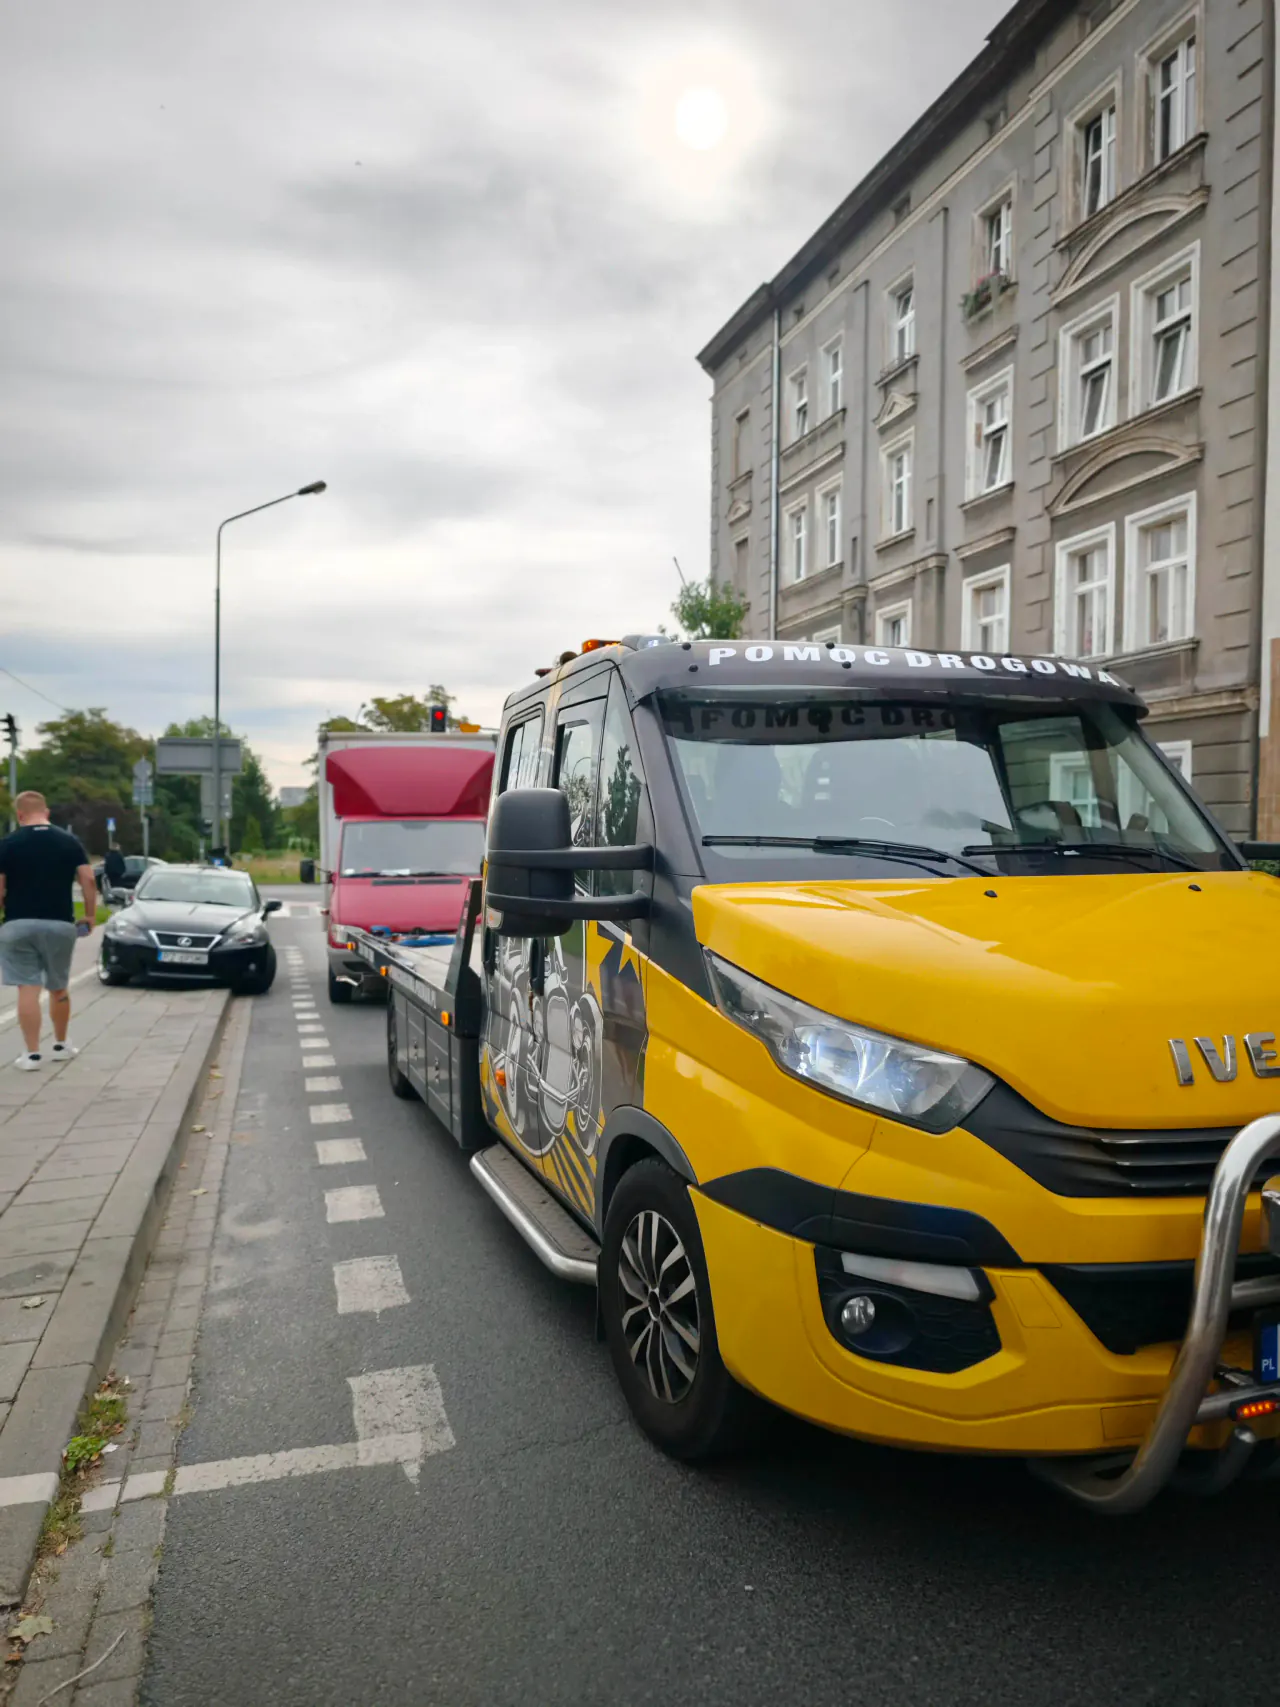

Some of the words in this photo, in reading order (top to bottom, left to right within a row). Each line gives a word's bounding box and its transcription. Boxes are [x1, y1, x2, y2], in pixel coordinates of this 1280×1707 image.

[709, 646, 890, 666] POMOC
[905, 652, 1120, 687] DROGOWA
[1168, 1032, 1280, 1086] IVE
[1262, 1358, 1276, 1372] PL
